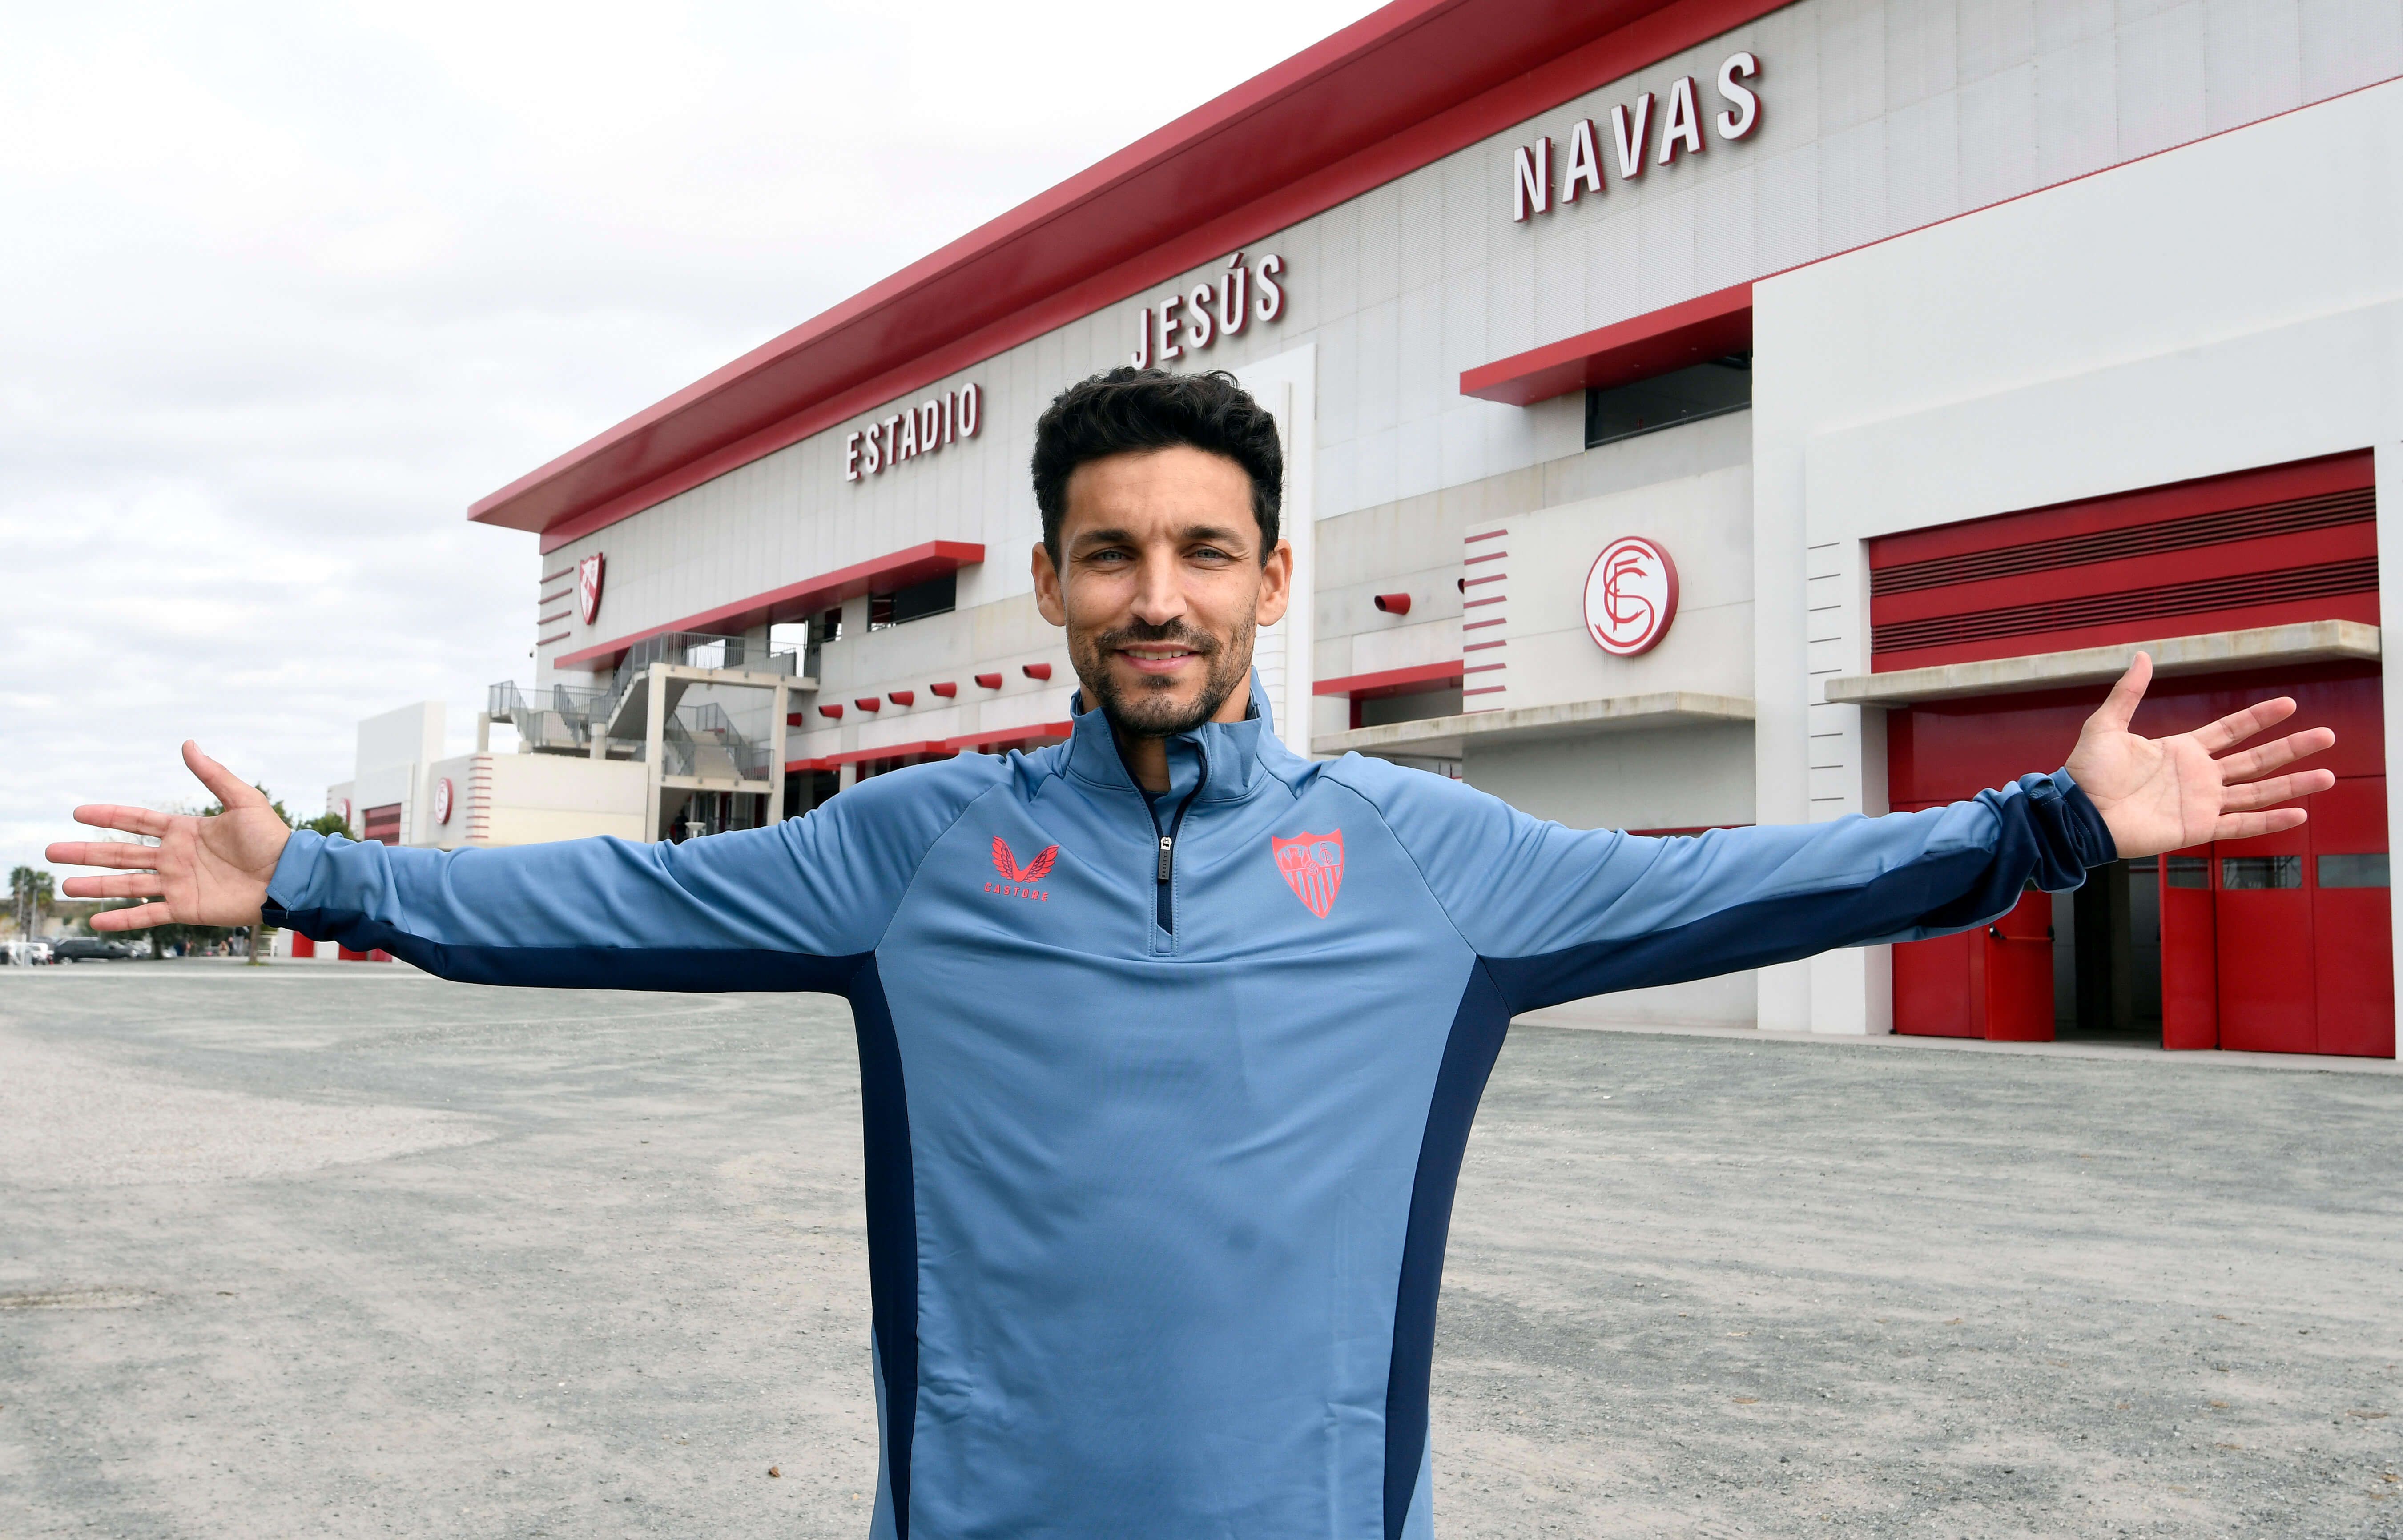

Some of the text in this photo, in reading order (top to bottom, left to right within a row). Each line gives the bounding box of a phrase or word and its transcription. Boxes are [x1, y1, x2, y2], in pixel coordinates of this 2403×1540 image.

[846, 51, 1761, 481] ESTADIO JESÚS NAVAS
[984, 882, 1049, 902] CASTORE
